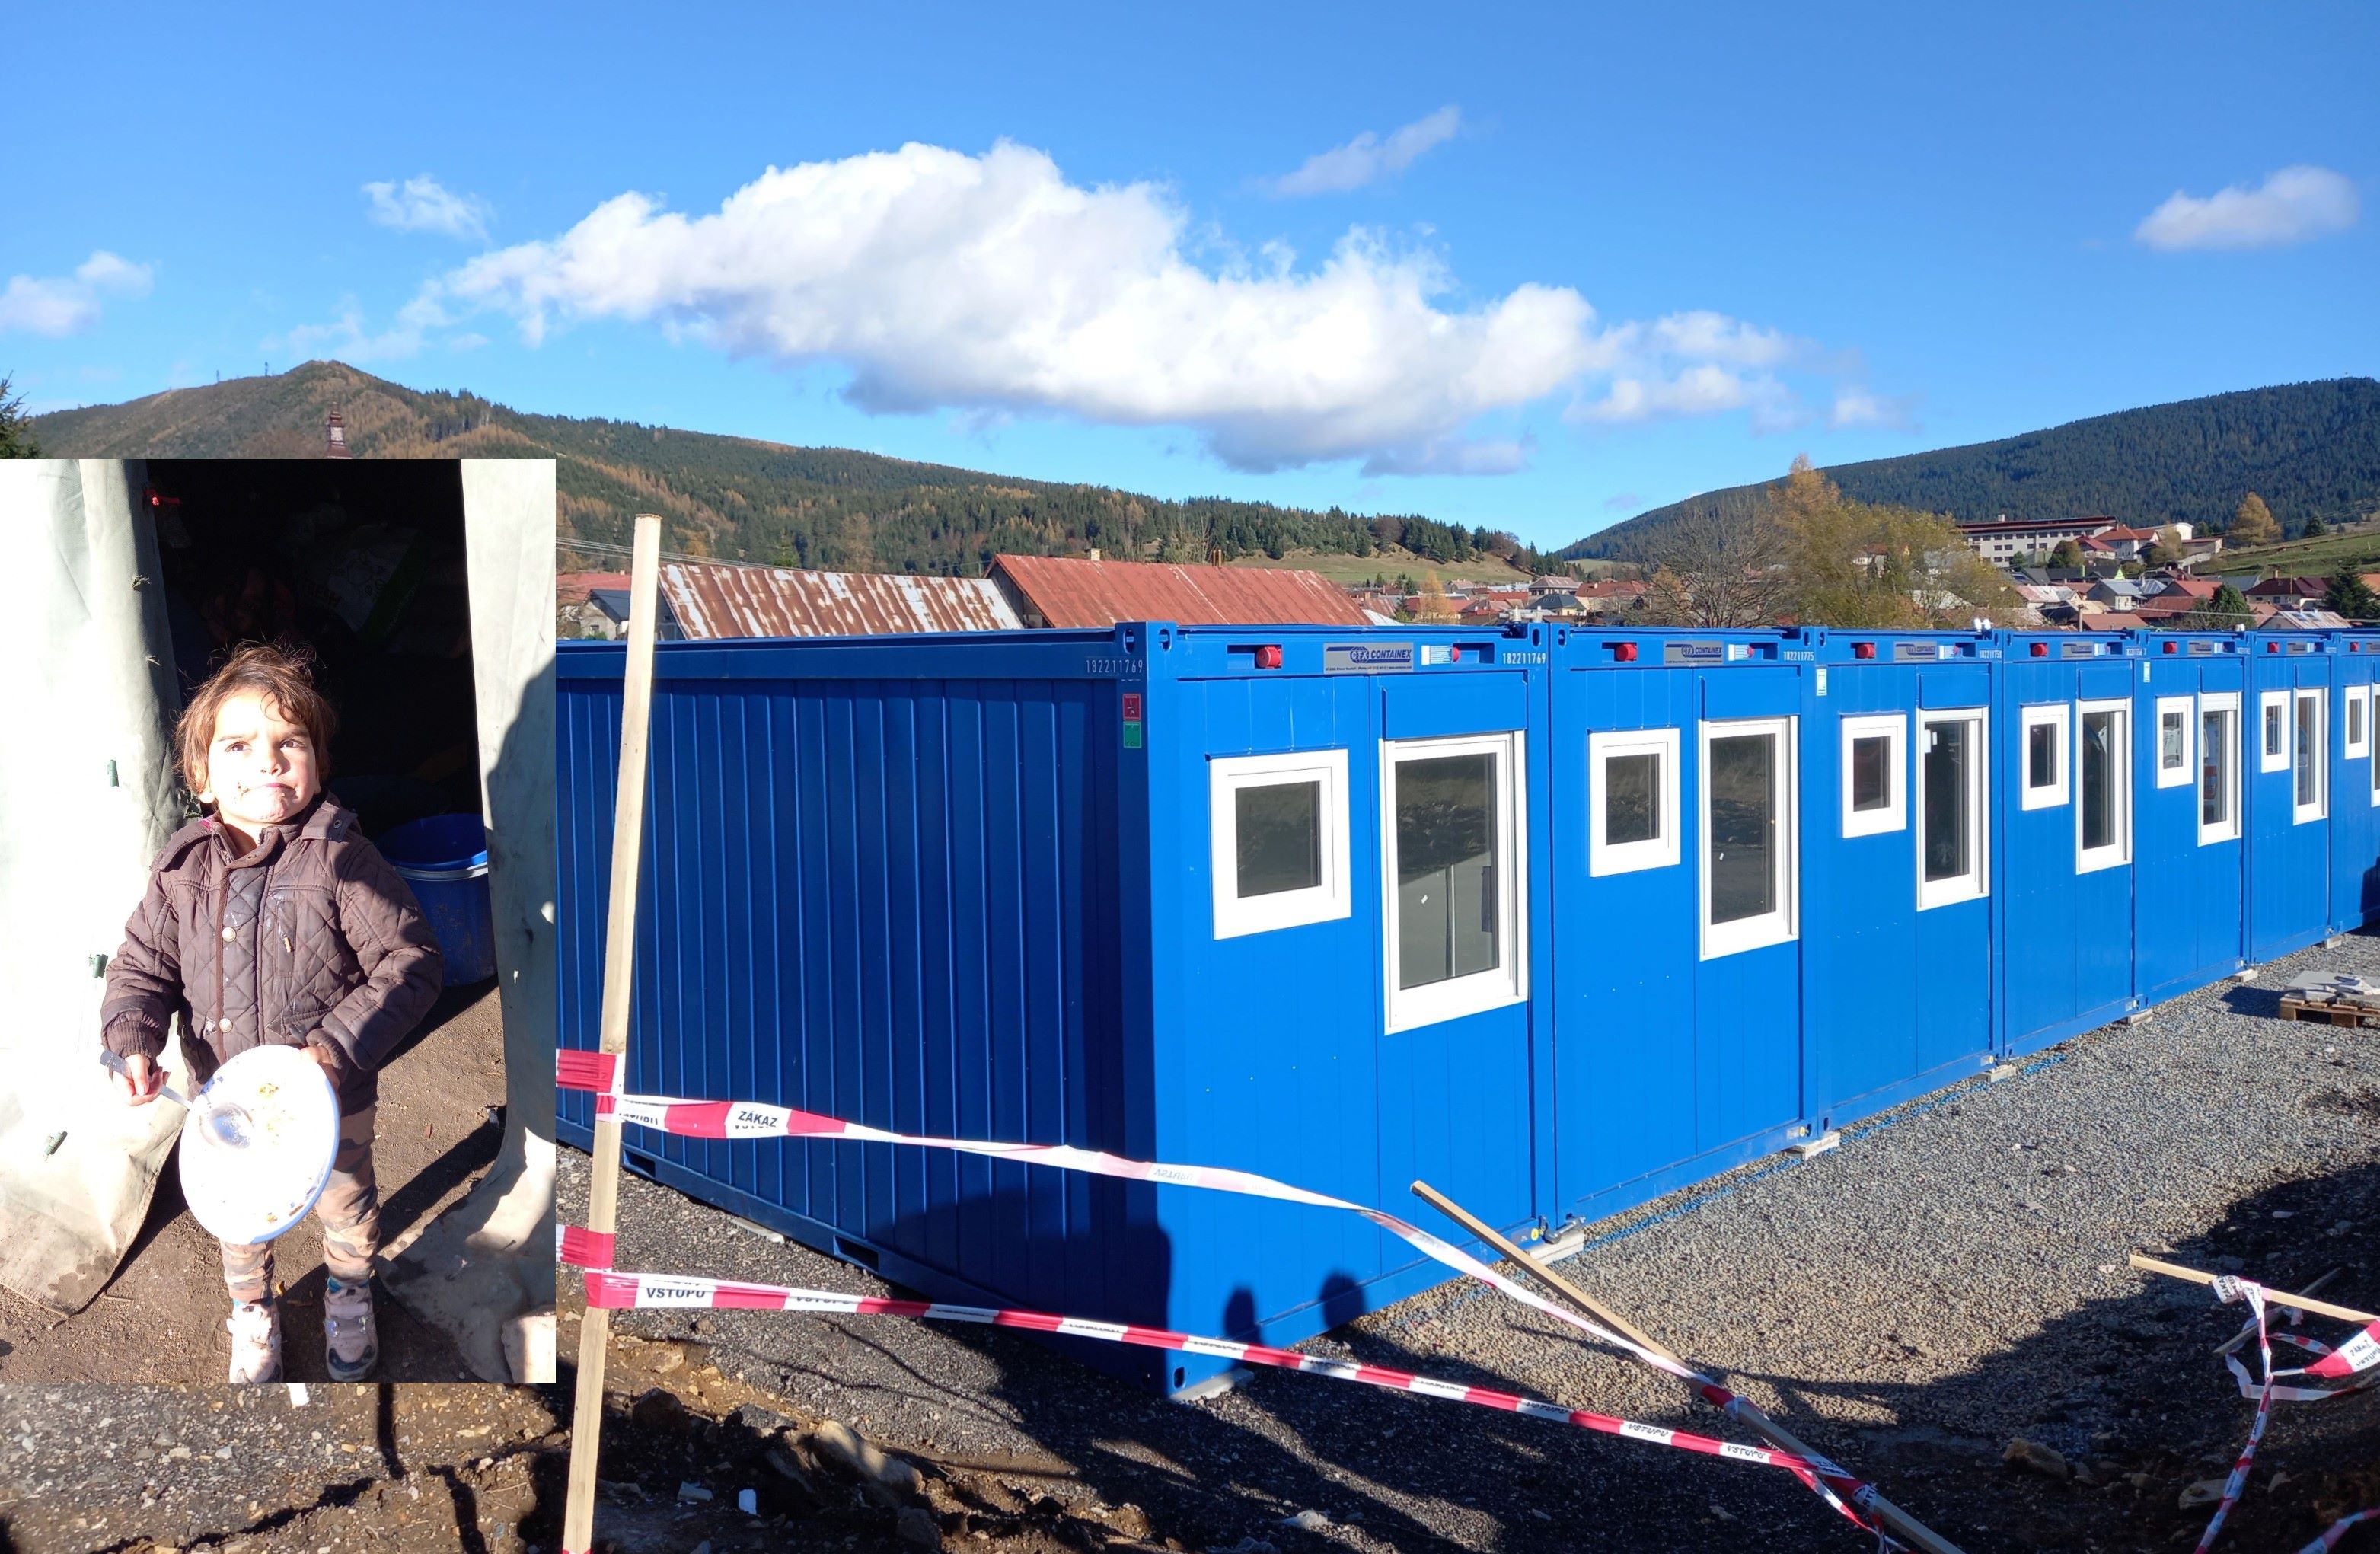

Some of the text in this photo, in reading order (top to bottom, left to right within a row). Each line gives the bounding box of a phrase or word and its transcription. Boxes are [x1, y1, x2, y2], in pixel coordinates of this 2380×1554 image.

[1371, 649, 1412, 659] CONTAINEX
[1502, 652, 1546, 665] 182211769
[1086, 659, 1143, 673] 182211769
[738, 1110, 778, 1128] ZÁKAZ
[646, 1288, 706, 1298] VSTUPU
[1628, 1422, 1669, 1438] VSTUPU
[1726, 1444, 1766, 1460] VSTUPU
